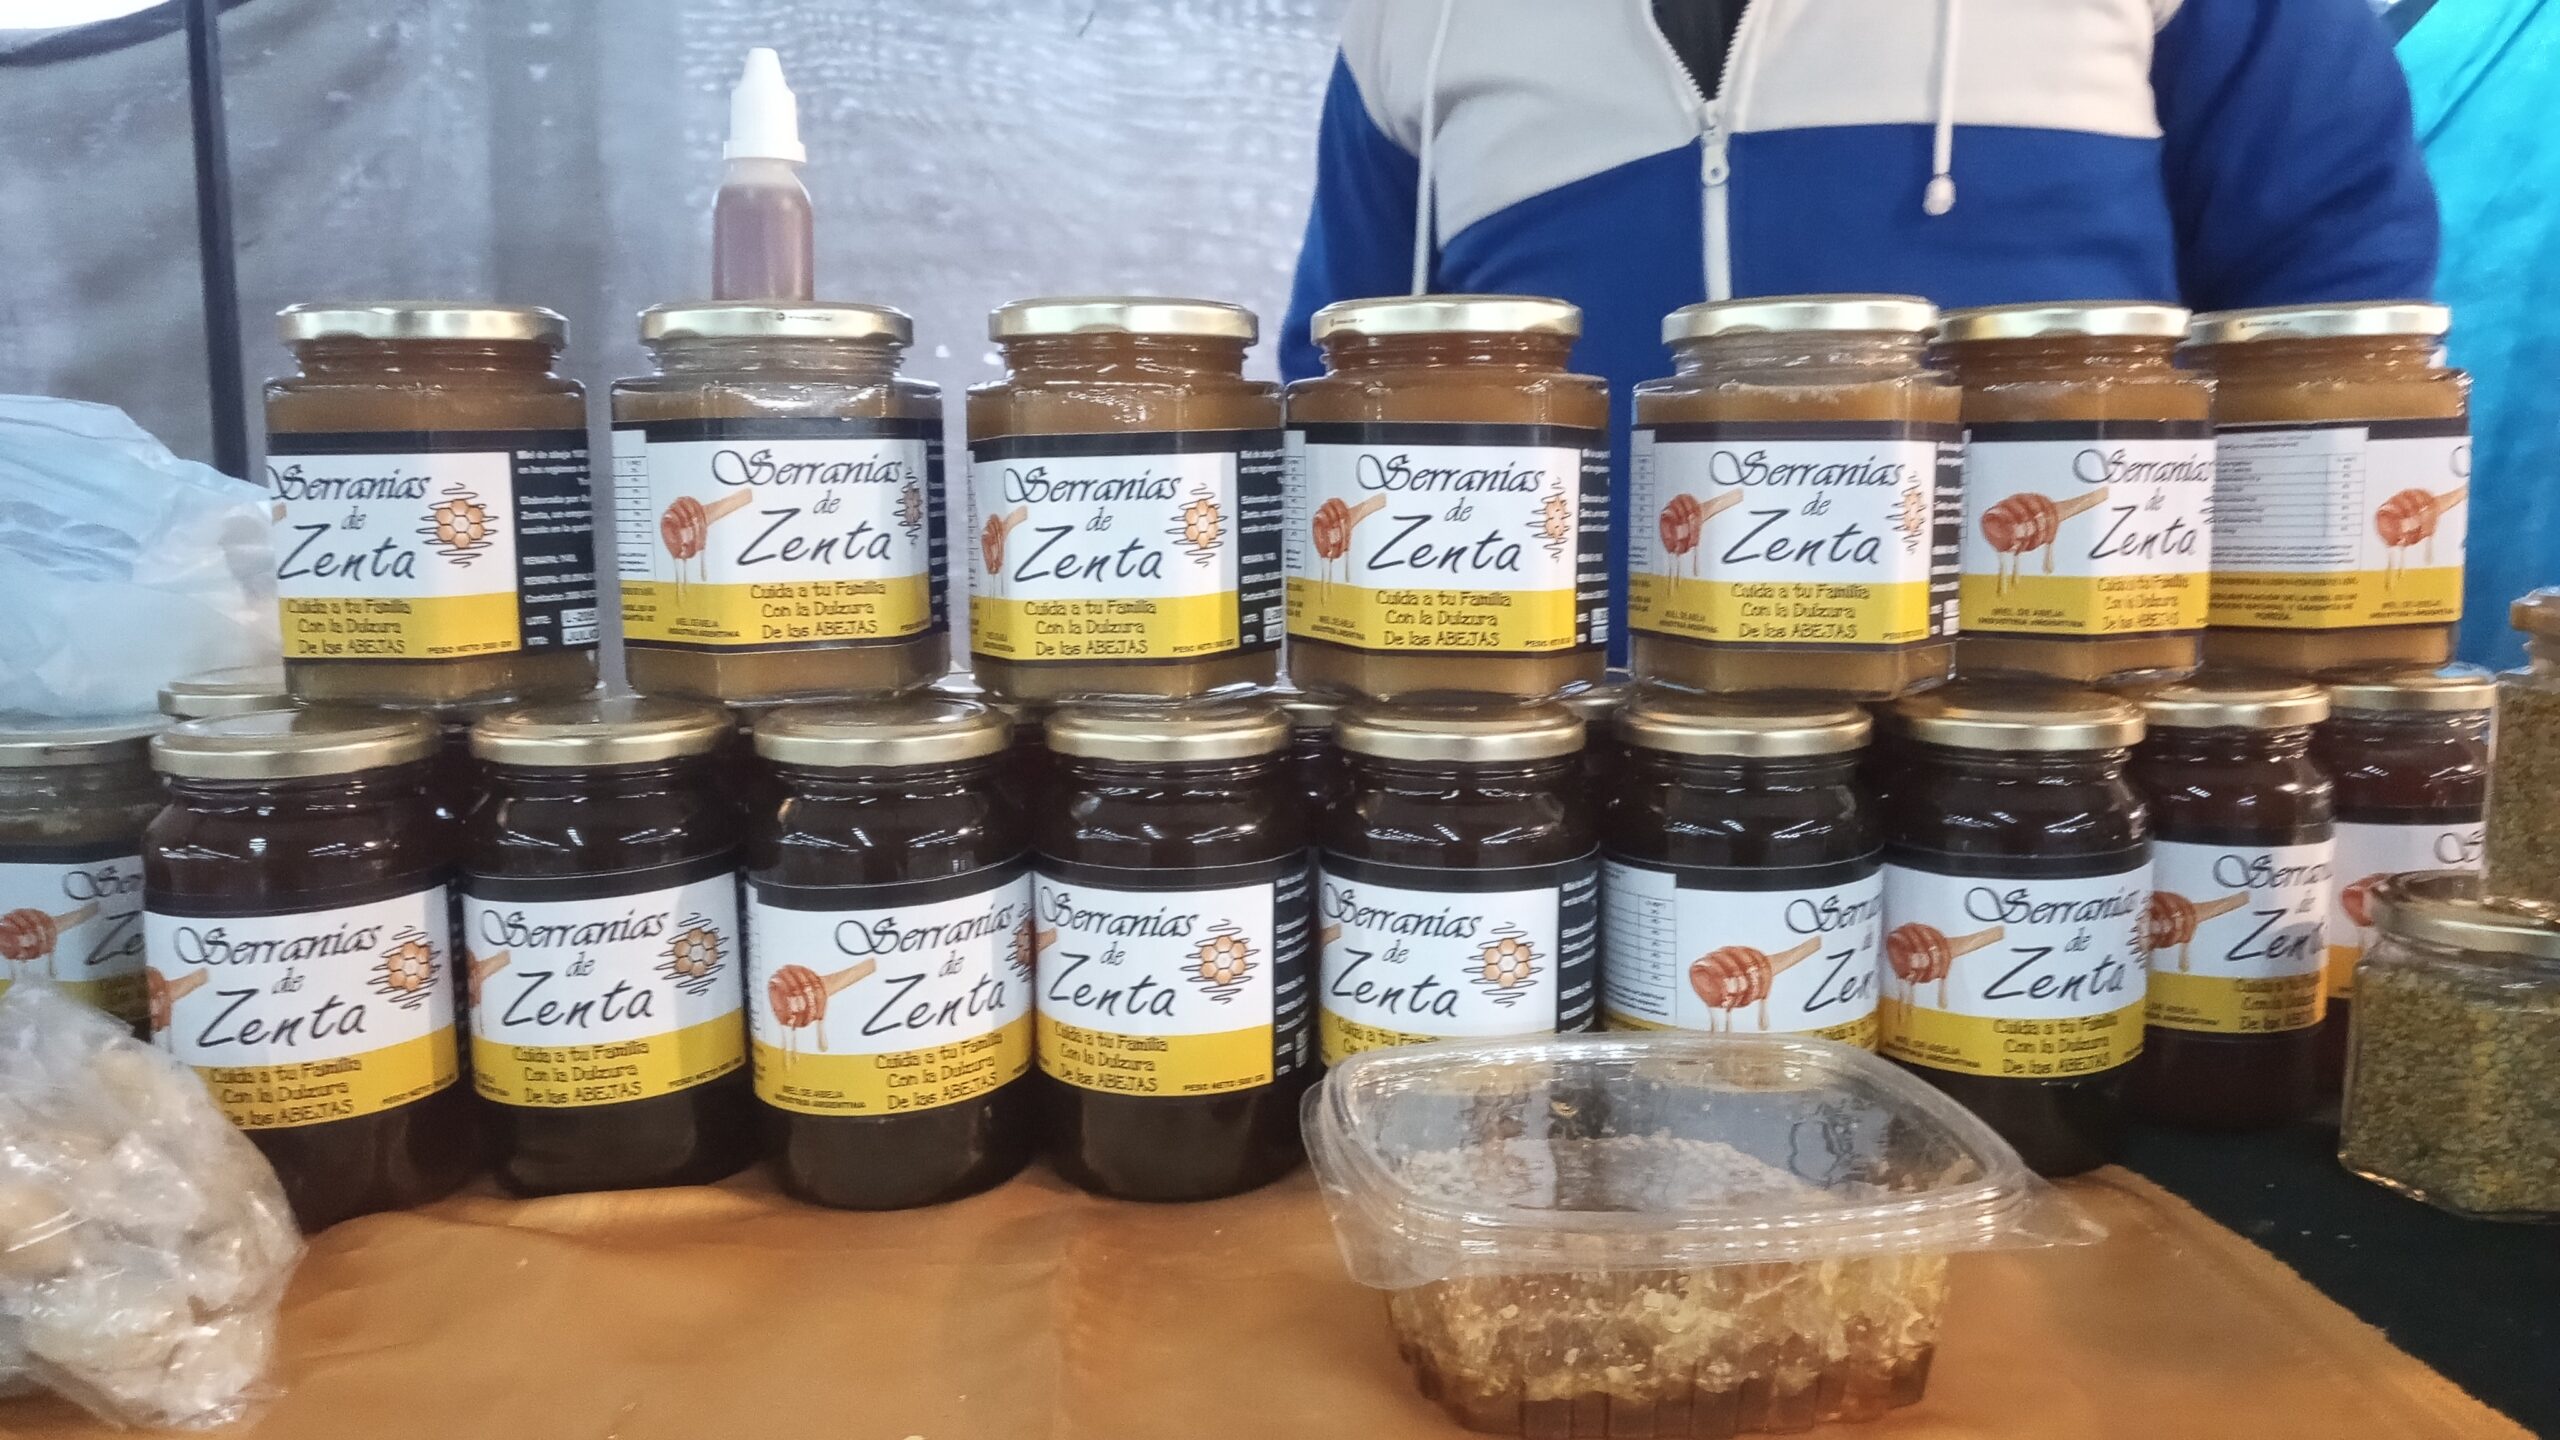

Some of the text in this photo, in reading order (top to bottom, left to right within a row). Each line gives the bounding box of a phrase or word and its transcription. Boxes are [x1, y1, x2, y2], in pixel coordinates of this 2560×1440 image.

[813, 489, 841, 514] de
[1444, 496, 1473, 522] de
[1800, 491, 1832, 516] de
[1086, 506, 1114, 531] de
[738, 507, 891, 565] Zenta
[1367, 514, 1522, 573] Zenta
[1721, 508, 1879, 565] Zenta
[2088, 505, 2197, 559] Zenta
[278, 524, 416, 581] Zenta
[1014, 525, 1162, 582] Zenta
[751, 581, 887, 599] Cuida a tu Familia
[1376, 590, 1511, 607] Cuida a tu Familia
[1731, 584, 1870, 599] Cuida a tu Familia
[762, 600, 875, 618] Con la Dulzura
[1025, 600, 1157, 616] Cuida a tu Familia
[1385, 610, 1498, 626] Con la Dulzura
[1740, 602, 1855, 618] Con la Dulzura
[762, 620, 877, 639] De las ABEJAS
[1035, 619, 1145, 635] Con la Dulzura
[1383, 631, 1500, 646] De las ABEJAS
[1738, 624, 1857, 639] De las ABEJAS
[1036, 639, 1148, 656] De las ABEJAS
[1383, 939, 1409, 964] de
[2064, 927, 2092, 952] de
[566, 951, 595, 977] de
[938, 951, 965, 977] de
[1100, 941, 1126, 966] de
[1048, 951, 1176, 1017] Zenta
[1331, 947, 1458, 1017] Zenta
[1982, 946, 2126, 1001] Zenta
[501, 971, 653, 1028] Zenta
[862, 973, 1006, 1036] Zenta
[196, 988, 367, 1048] Zenta
